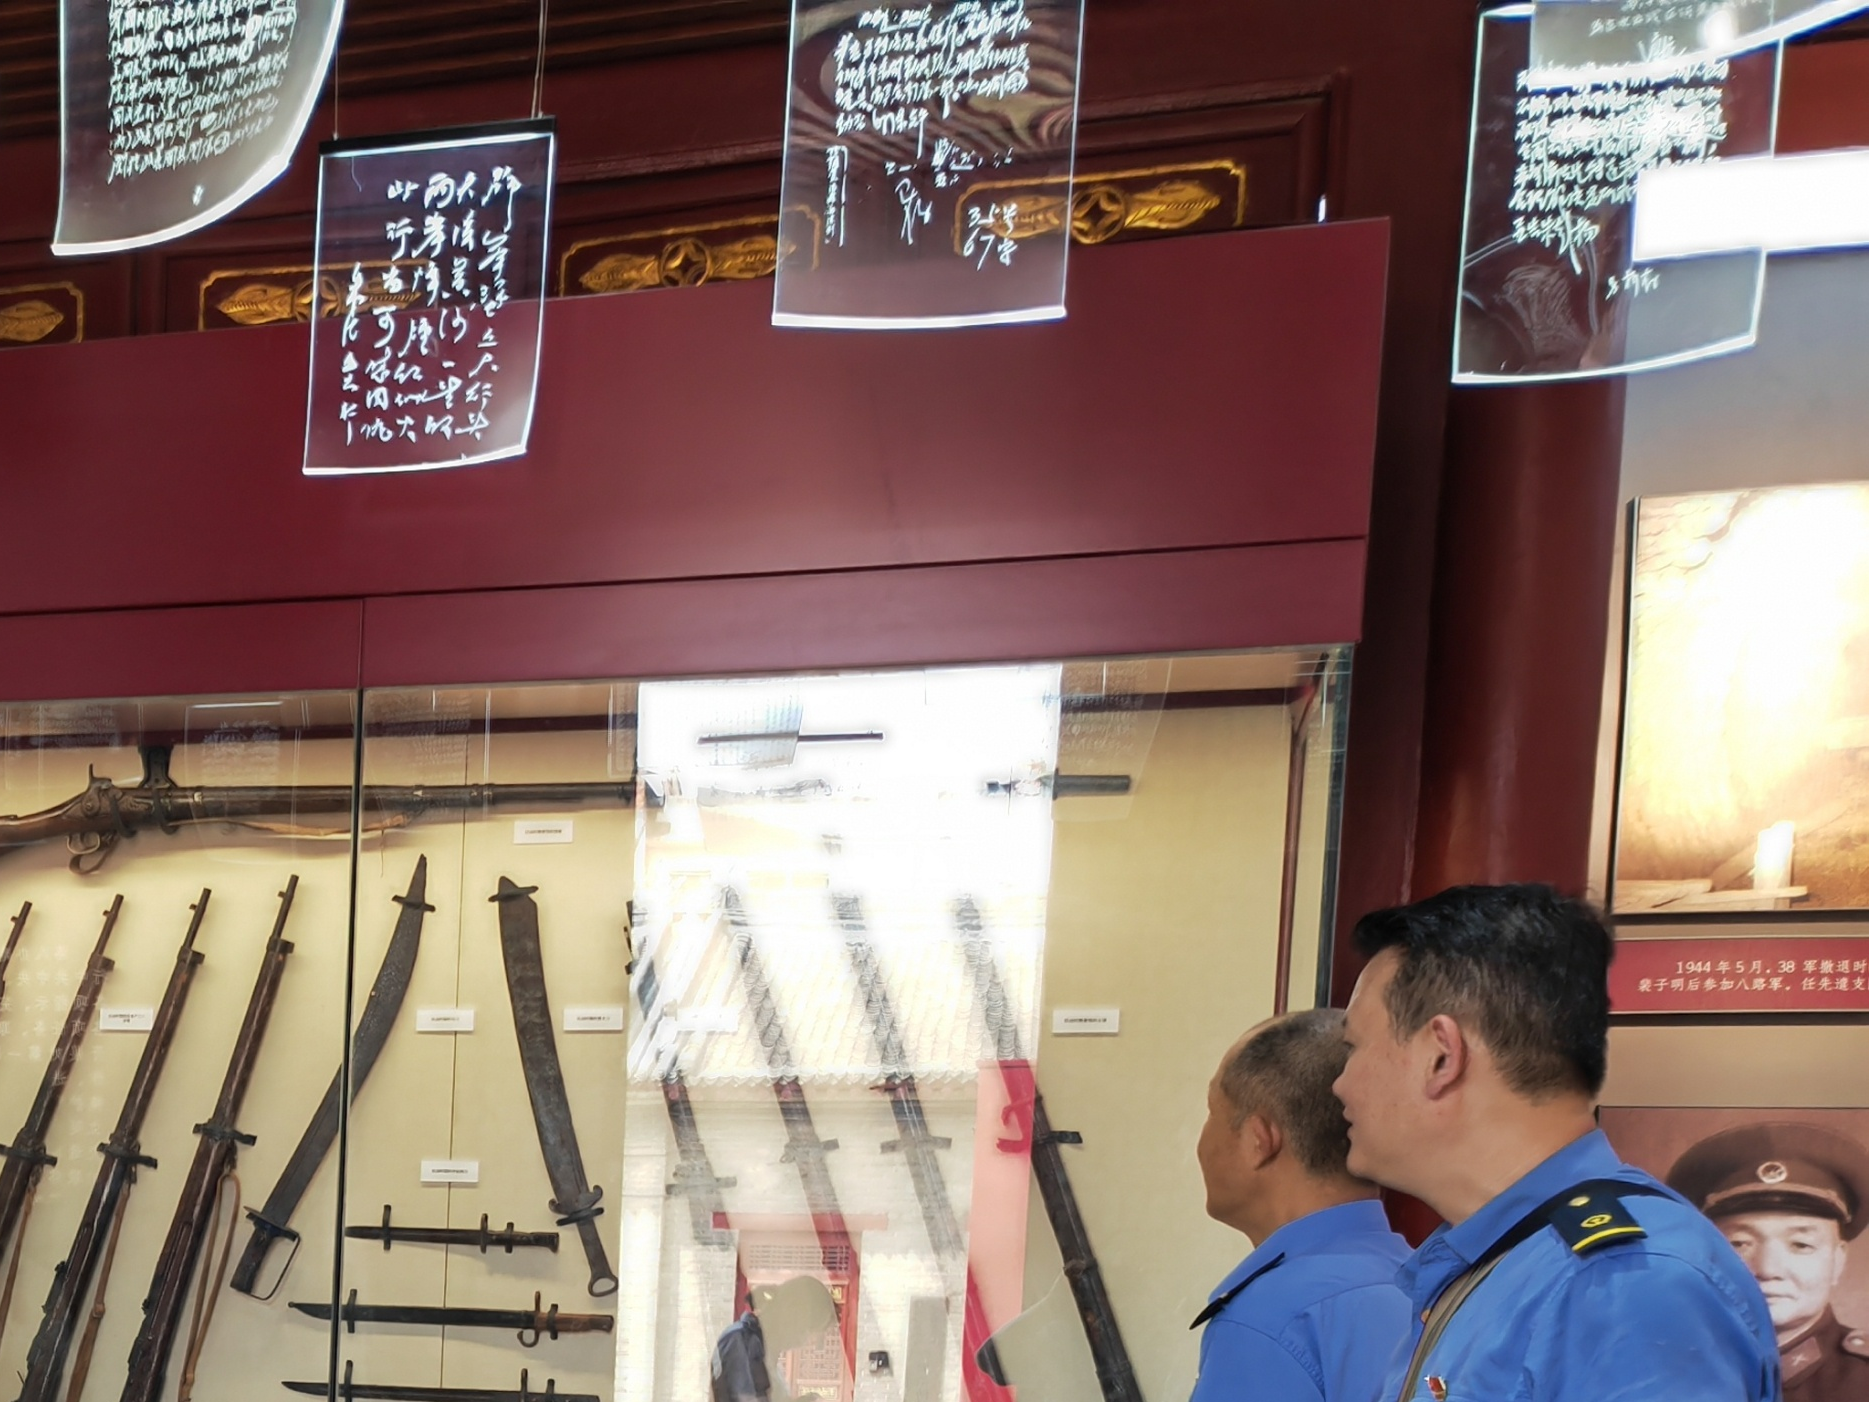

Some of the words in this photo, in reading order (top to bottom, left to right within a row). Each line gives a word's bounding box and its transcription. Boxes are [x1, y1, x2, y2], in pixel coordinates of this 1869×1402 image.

[1637, 977, 1869, 993] 裴子明后参加八路军，任先遣支
